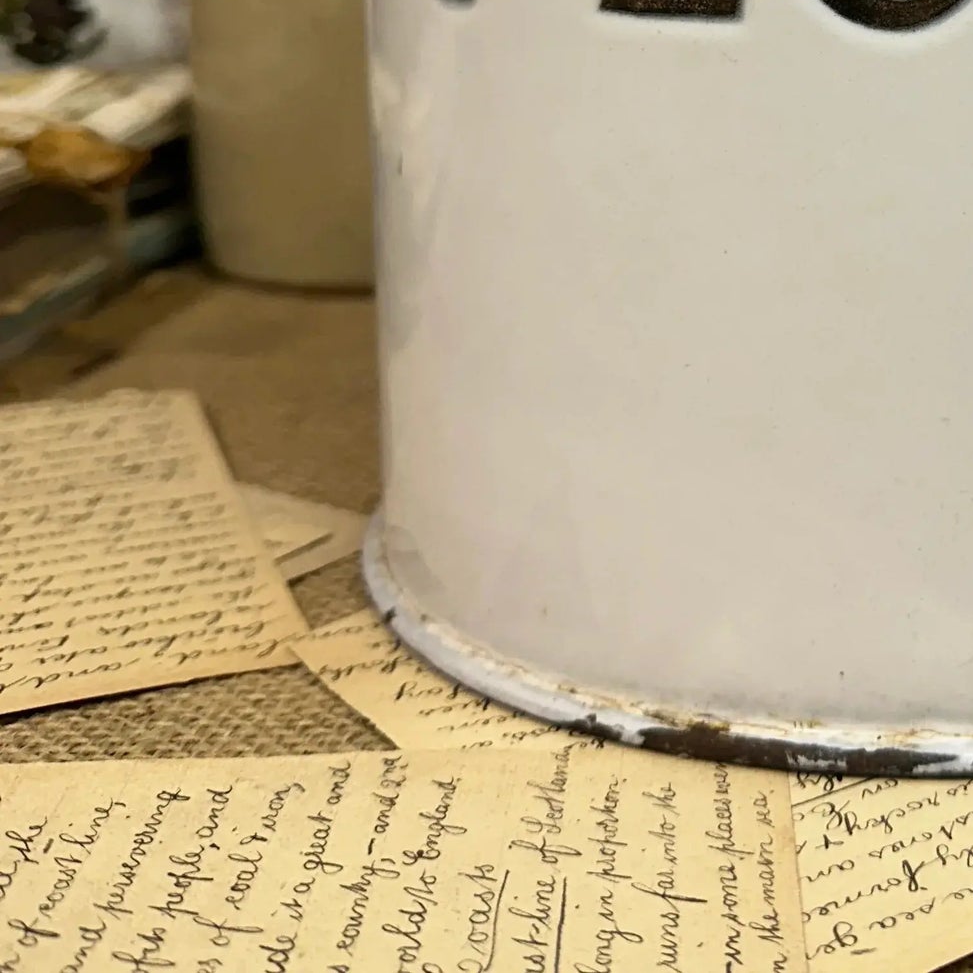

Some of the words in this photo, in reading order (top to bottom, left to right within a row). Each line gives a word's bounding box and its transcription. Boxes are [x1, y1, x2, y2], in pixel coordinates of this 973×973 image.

[196, 785, 232, 838] and
[373, 792, 399, 834] and
[642, 782, 681, 817] the
[843, 791, 941, 836] rocky
[293, 877, 316, 894] a
[327, 762, 351, 805] and
[511, 836, 583, 865] of
[8, 917, 60, 946] of
[38, 854, 82, 918] coast
[225, 850, 263, 910] coal
[631, 869, 708, 913] far
[720, 859, 747, 927] some
[193, 915, 264, 947] of
[749, 907, 784, 945] the
[868, 896, 936, 931] sea
